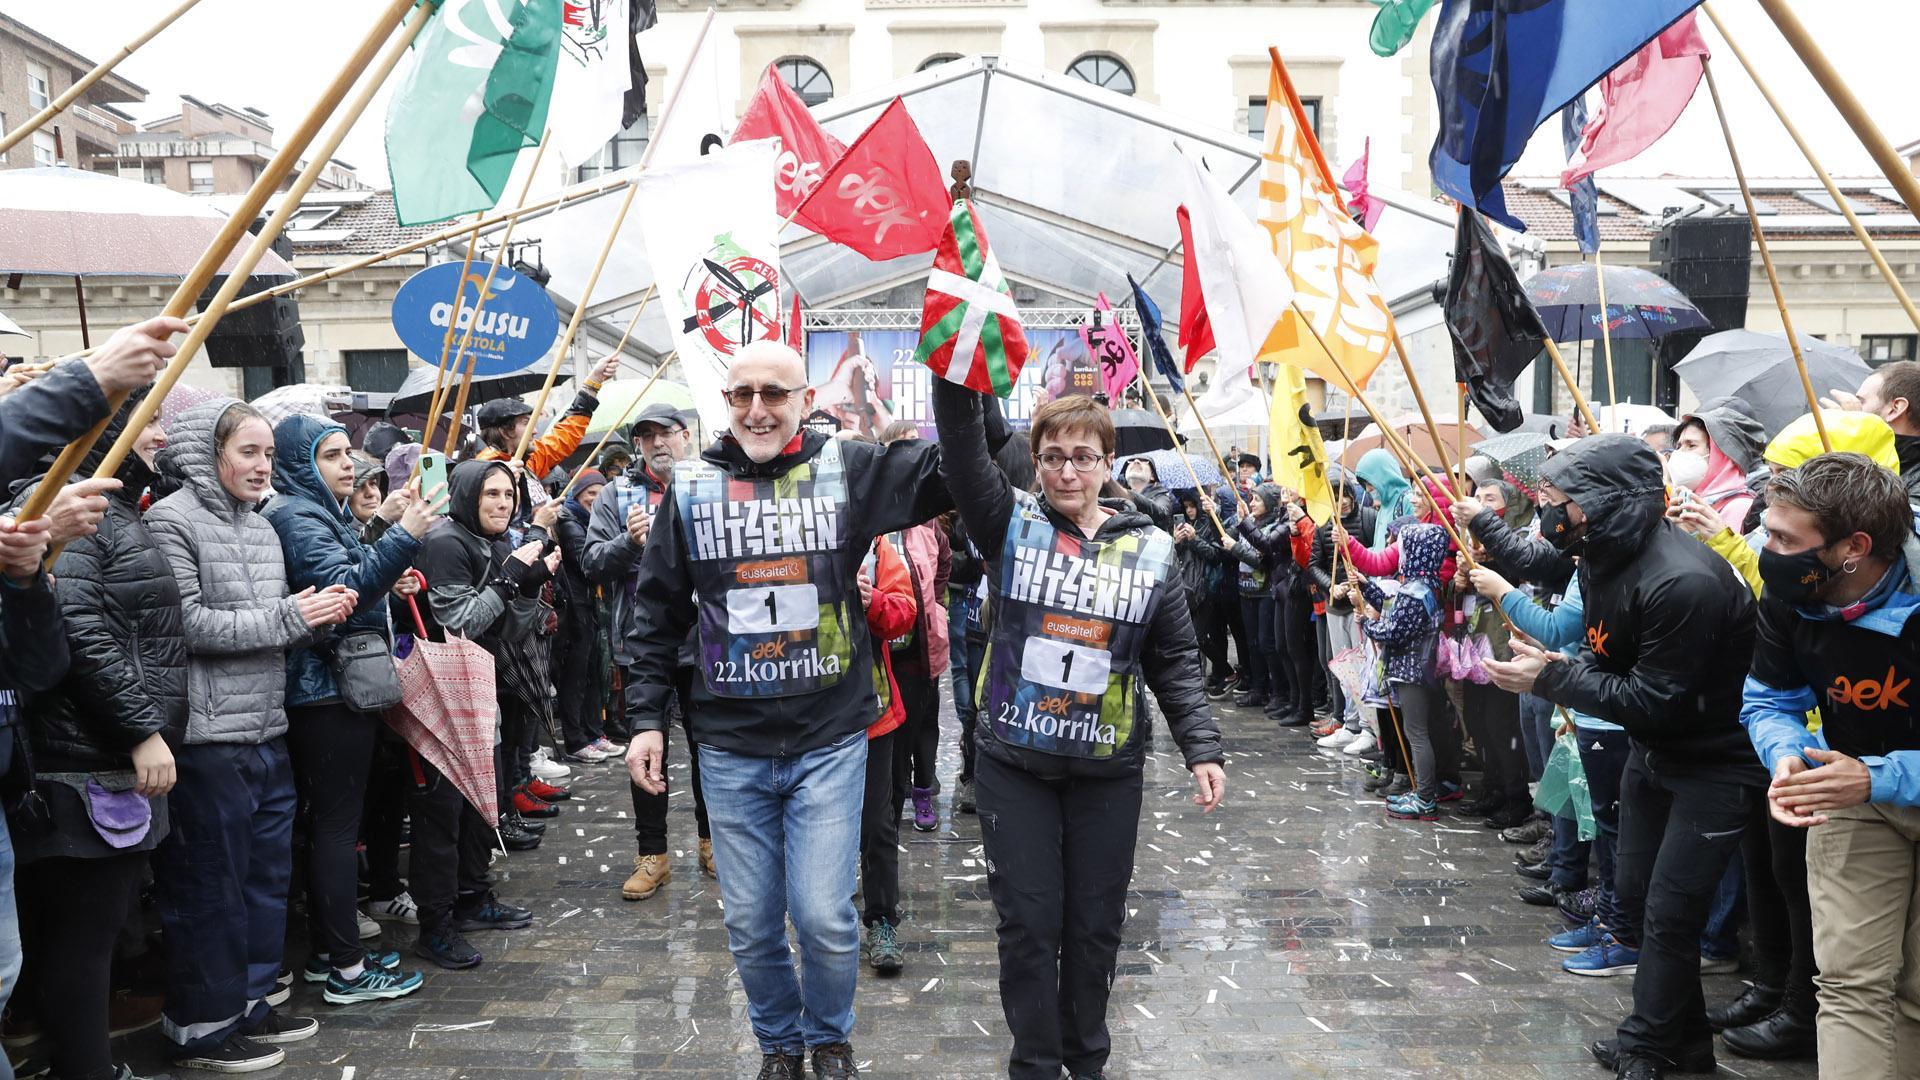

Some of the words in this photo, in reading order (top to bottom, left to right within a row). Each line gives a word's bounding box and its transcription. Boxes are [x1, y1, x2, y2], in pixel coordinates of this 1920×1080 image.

[430, 296, 530, 339] abusu
[741, 565, 788, 580] euskaltel
[765, 591, 777, 625] 1
[1047, 621, 1093, 638] euskaltel
[752, 634, 786, 660] aek
[1061, 650, 1074, 683] 1
[1827, 665, 1911, 711] aek
[1037, 693, 1072, 716] aek
